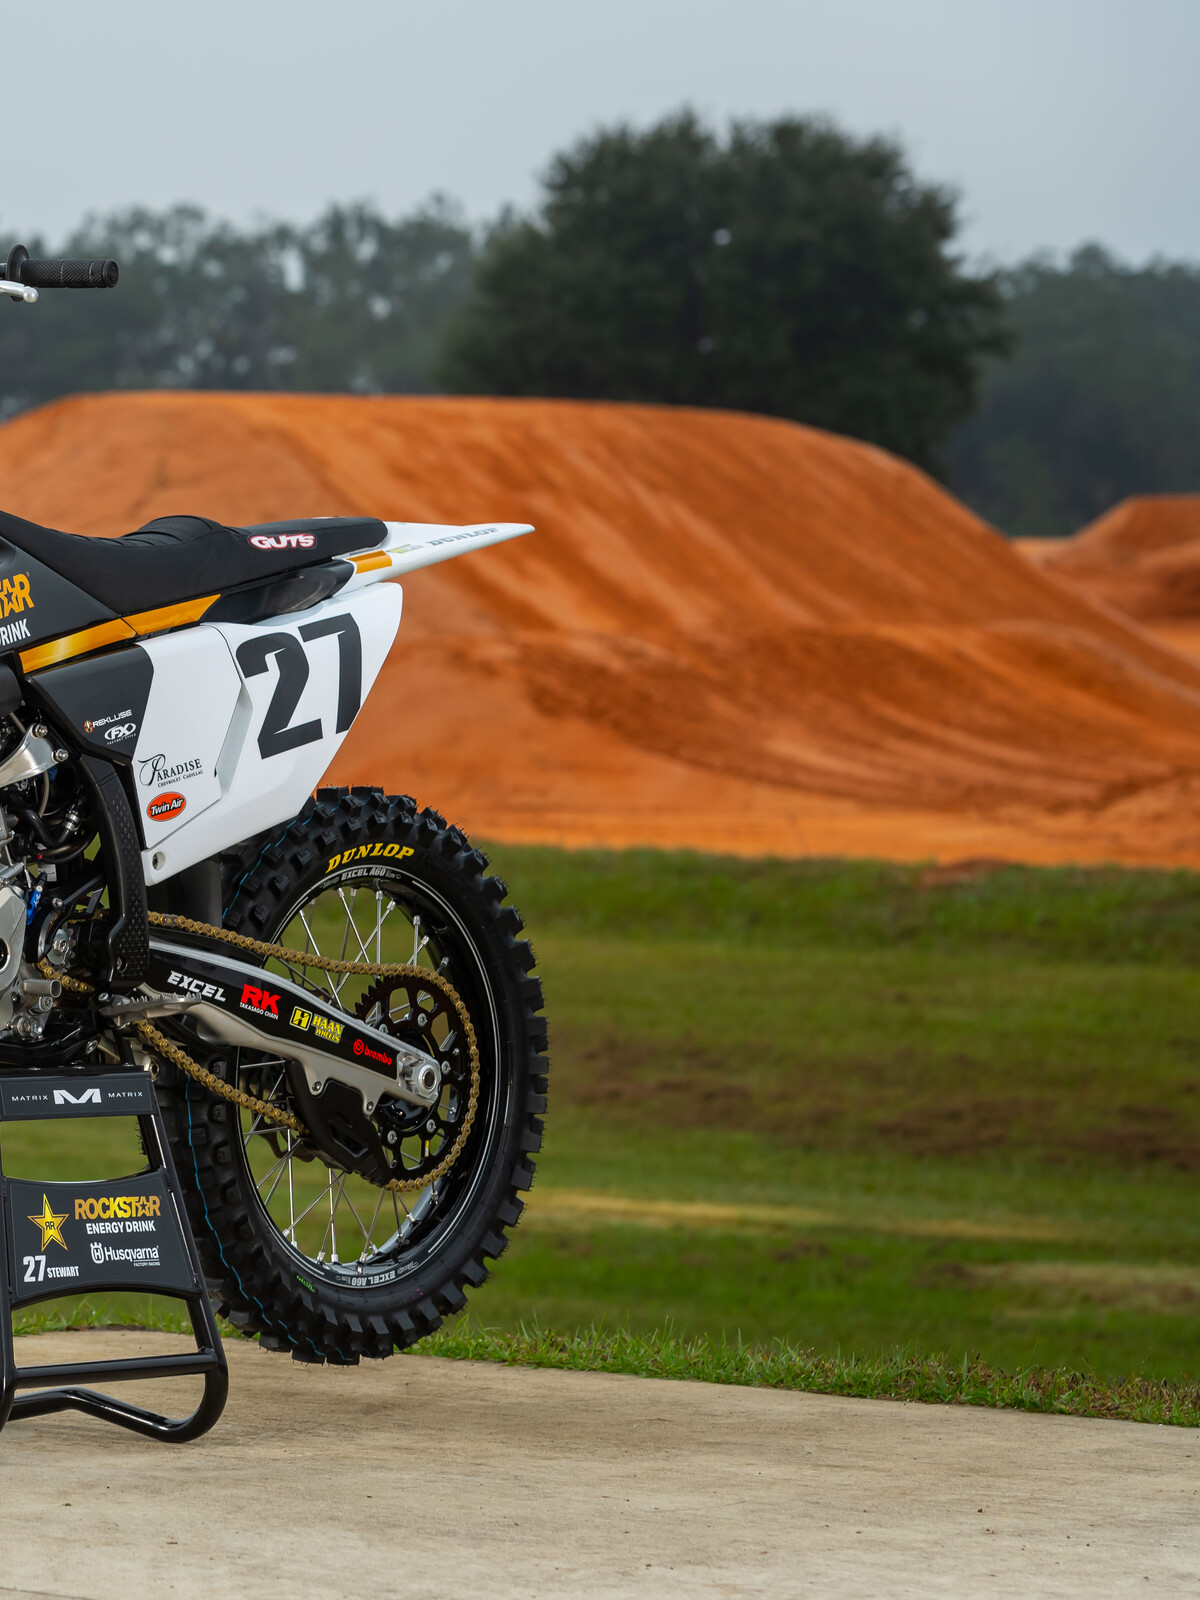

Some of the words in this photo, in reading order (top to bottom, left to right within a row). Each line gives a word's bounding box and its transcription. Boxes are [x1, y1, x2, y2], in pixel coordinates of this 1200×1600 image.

[250, 533, 315, 549] GUTS
[425, 527, 499, 546] DUNLOP
[235, 612, 363, 760] 27
[92, 709, 132, 728] REKLUSE
[138, 754, 202, 786] PARADISE
[151, 802, 170, 816] Twin
[170, 798, 184, 811] Air
[325, 843, 415, 873] DUNLOP
[341, 868, 369, 881] EXCEL
[370, 868, 386, 876] A60
[167, 971, 226, 1002] EXCEL
[240, 984, 281, 1015] RK
[240, 1002, 263, 1015] TAKASAGO
[264, 1011, 279, 1020] CHAIN
[312, 1015, 343, 1035] HAAN
[316, 1028, 340, 1043] WHEELS
[364, 1048, 392, 1066] brembo
[74, 1196, 161, 1220] ROCKSTAR
[86, 1221, 124, 1234] ENERGY
[125, 1220, 156, 1232] DRINK
[104, 1246, 159, 1262] Husqvarna
[23, 1255, 46, 1282] 27
[47, 1266, 79, 1279] STEWART
[368, 1270, 395, 1285] EXCEL
[352, 1277, 366, 1286] A60
